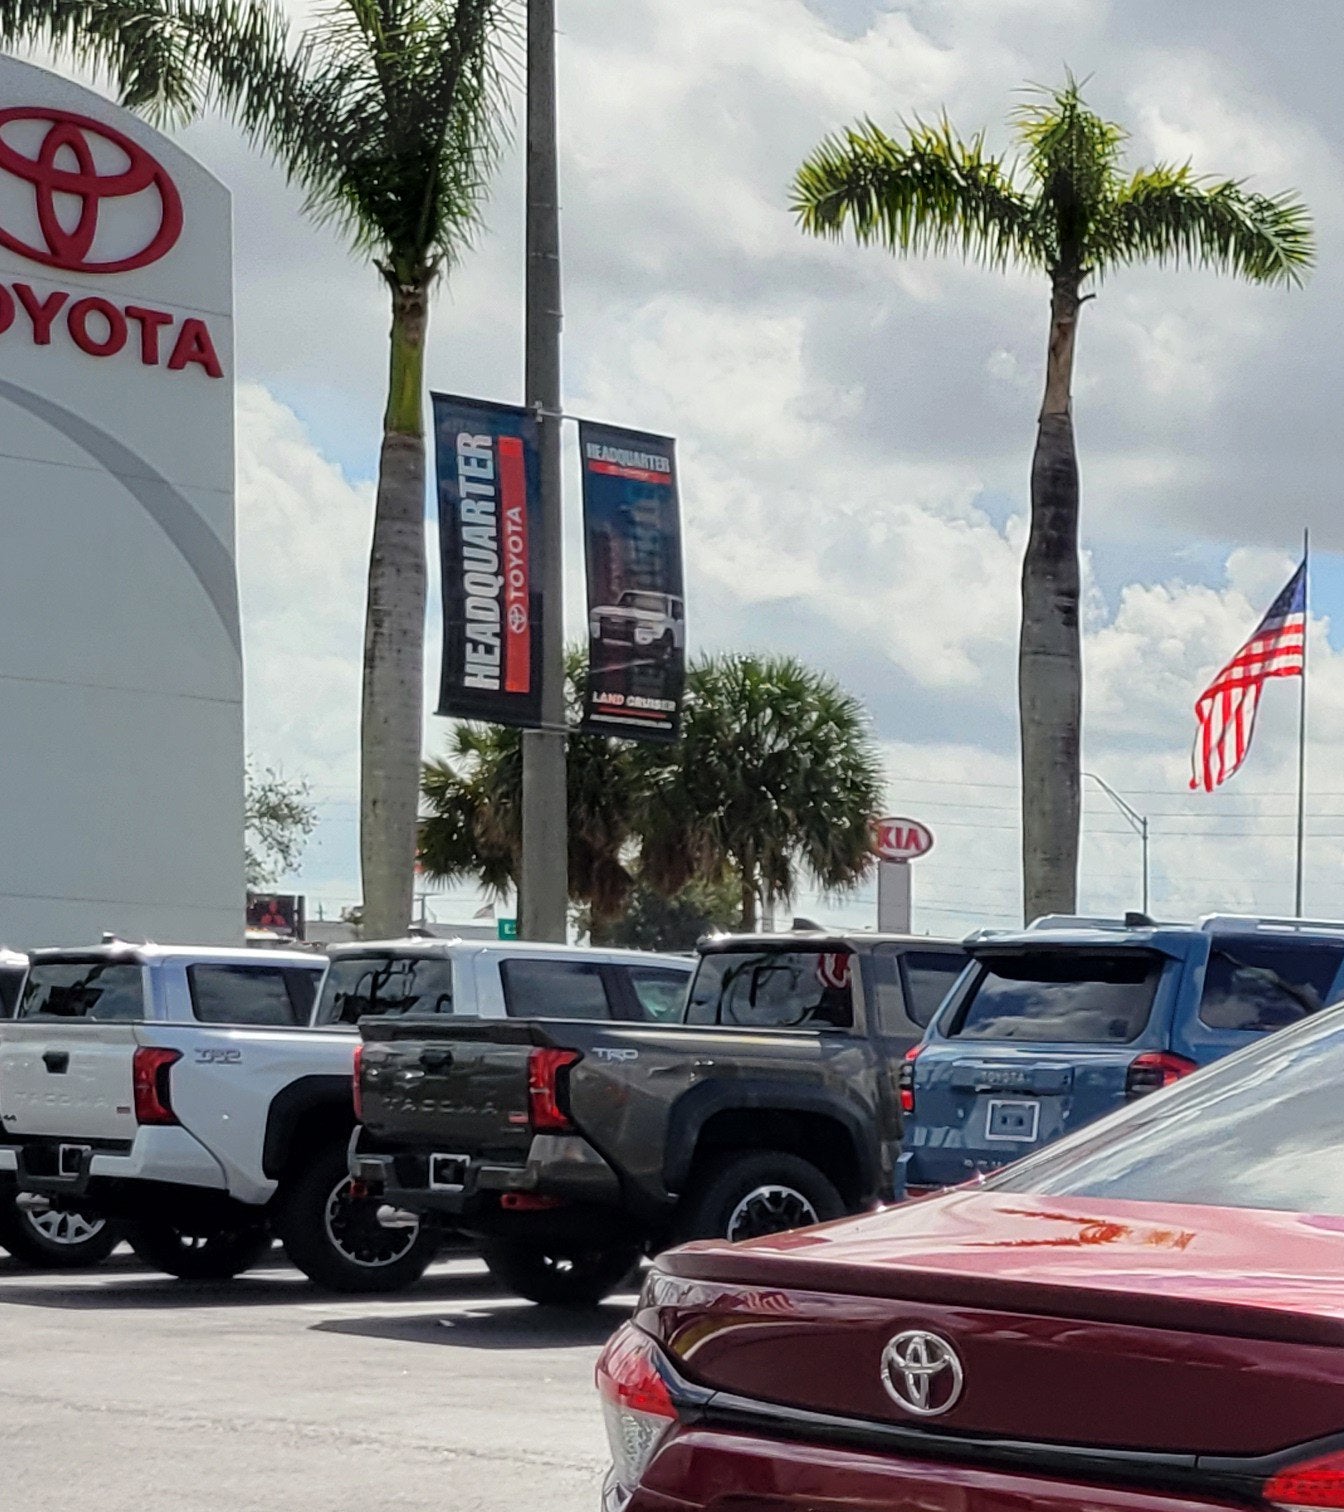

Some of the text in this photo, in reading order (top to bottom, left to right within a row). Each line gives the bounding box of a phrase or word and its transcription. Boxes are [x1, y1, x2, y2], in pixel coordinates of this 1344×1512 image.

[0, 283, 224, 379] YOTA
[586, 441, 671, 474] HEADQUARTER
[456, 431, 506, 691] HEADQUARTER
[506, 505, 526, 600] TOYOTA
[592, 690, 677, 712] LAND CRUISER
[877, 825, 923, 851] KIA
